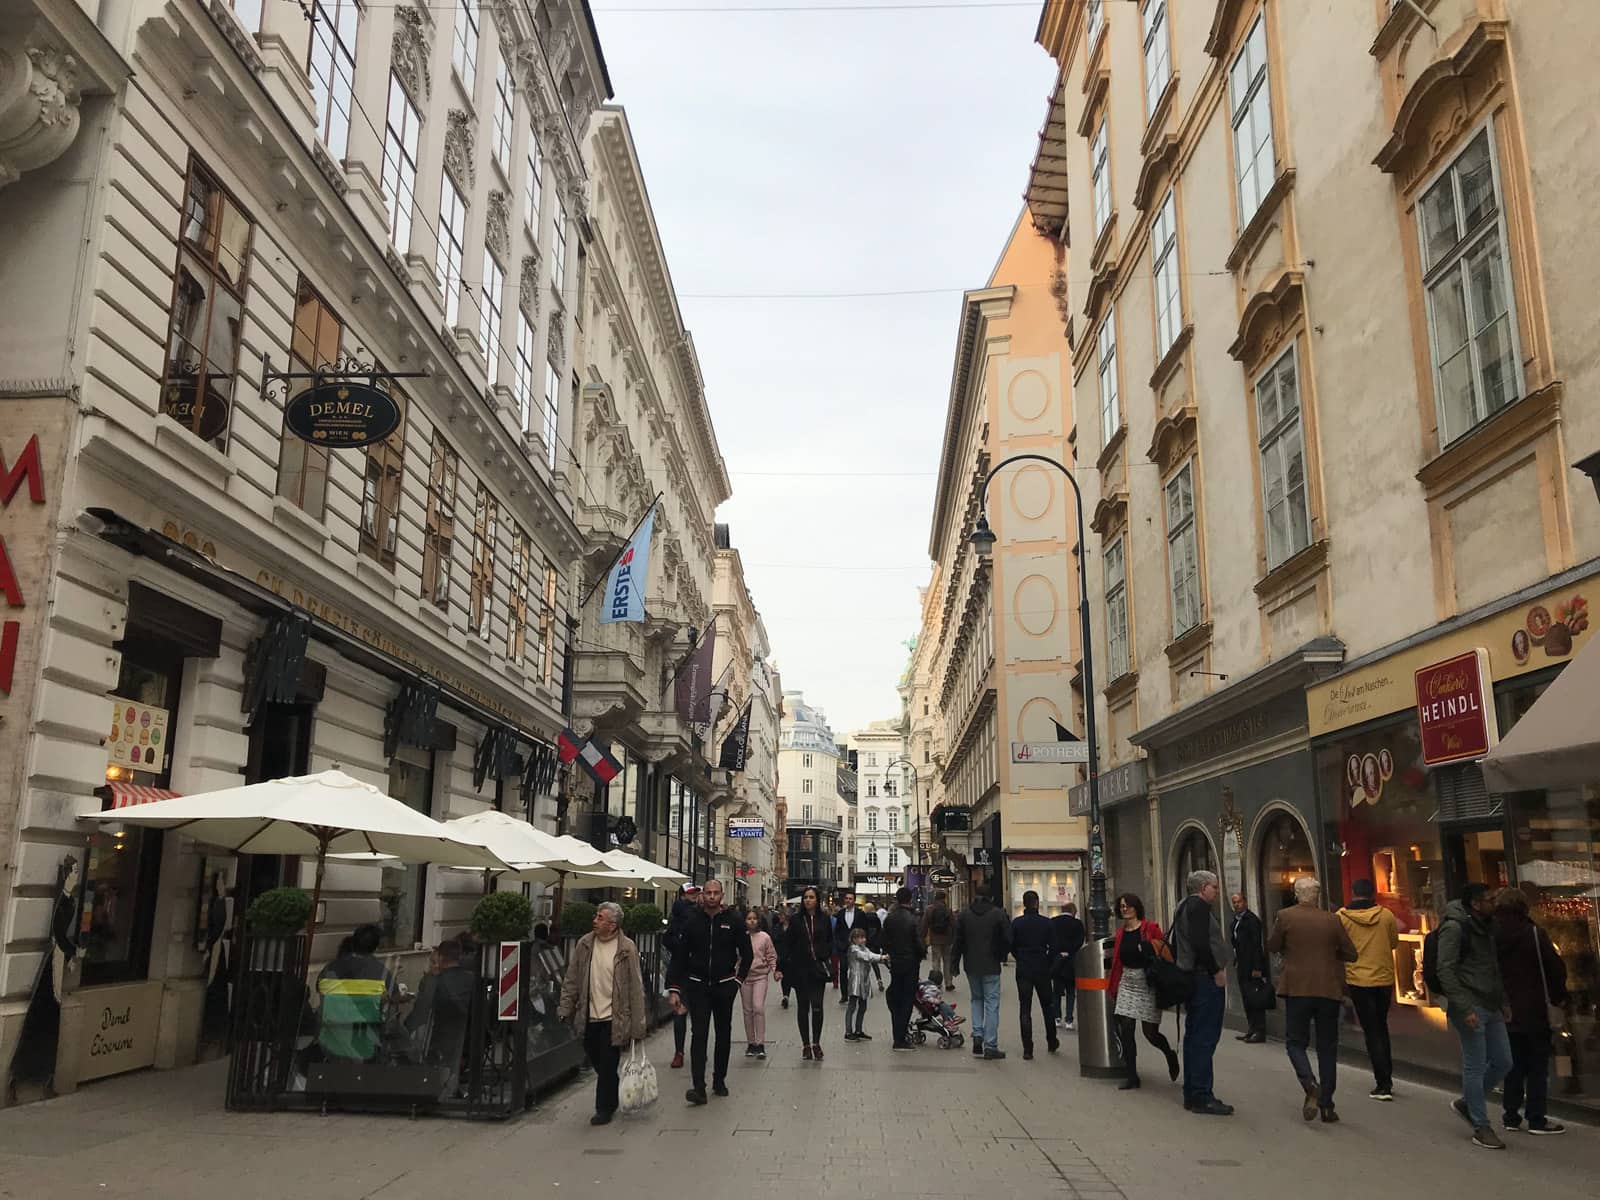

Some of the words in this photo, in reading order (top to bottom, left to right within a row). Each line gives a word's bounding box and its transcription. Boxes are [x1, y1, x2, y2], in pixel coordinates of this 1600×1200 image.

[309, 401, 374, 418] DEMEL
[612, 565, 631, 619] ERSTE
[1422, 692, 1479, 723] HEINDL
[1017, 743, 1089, 760] APOTHEKE
[1077, 767, 1130, 809] APHEKE
